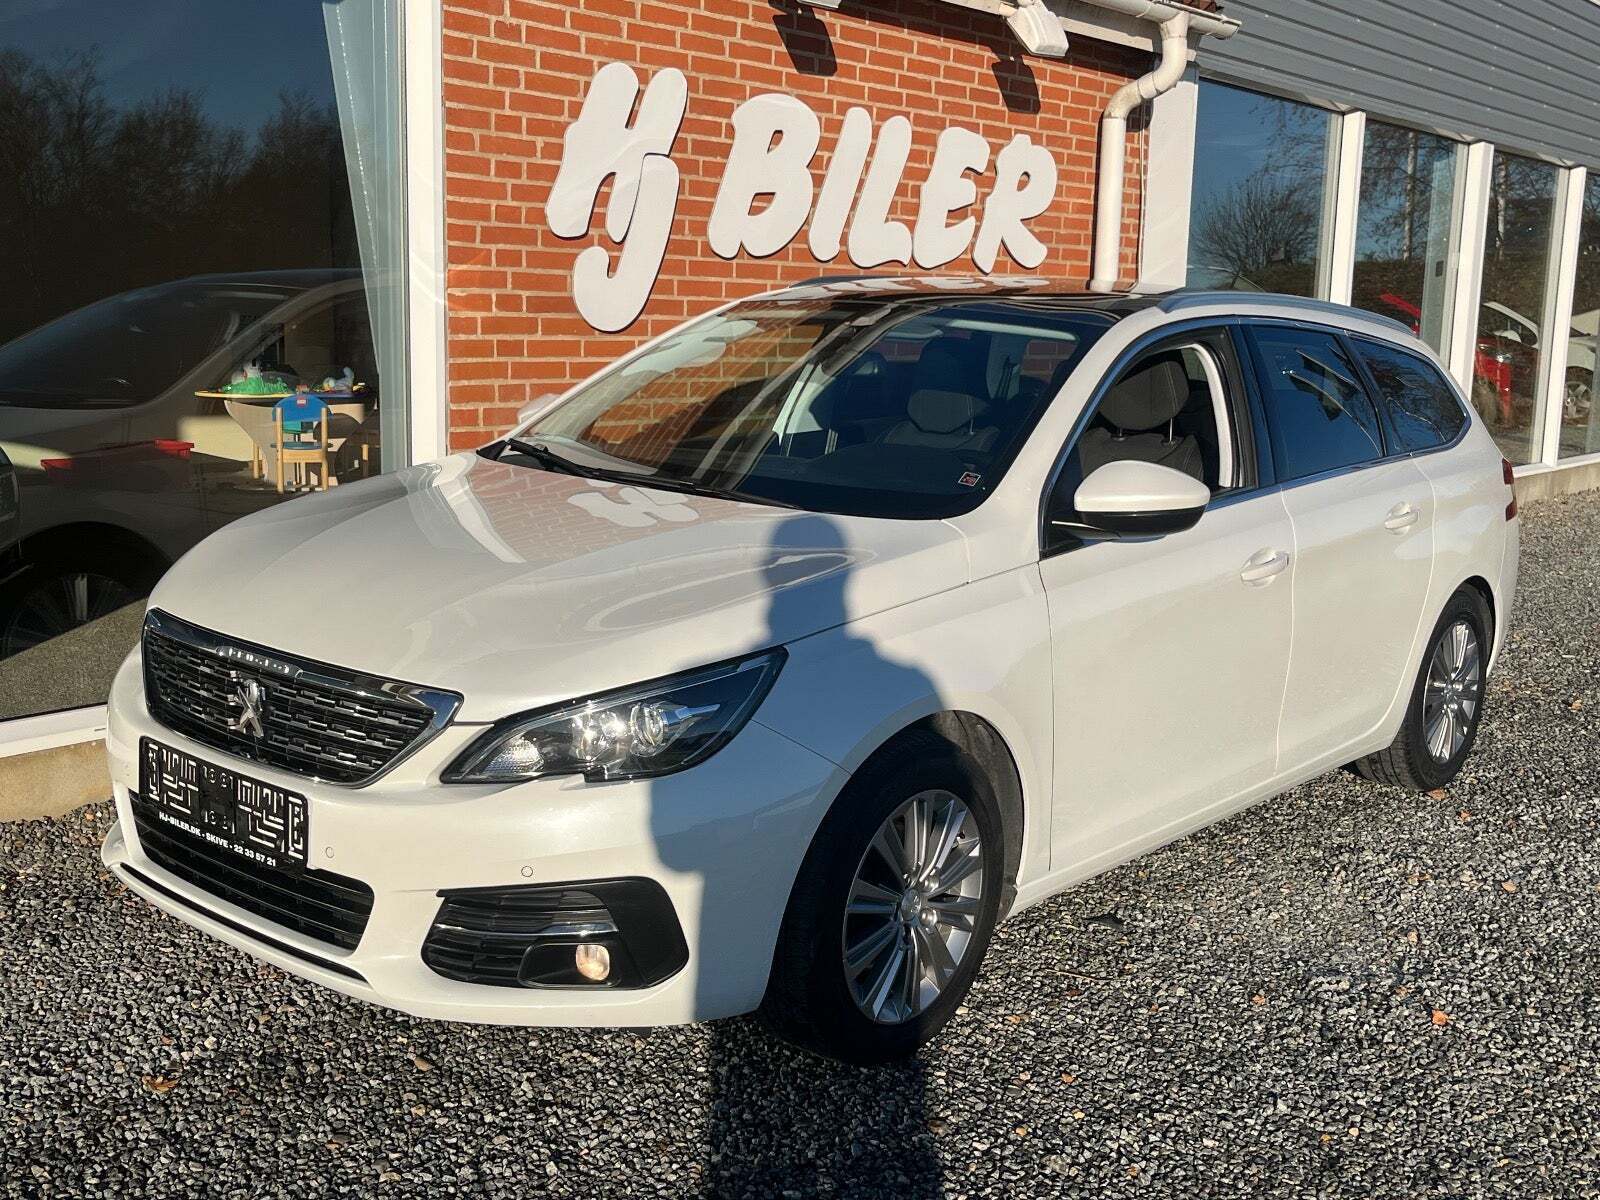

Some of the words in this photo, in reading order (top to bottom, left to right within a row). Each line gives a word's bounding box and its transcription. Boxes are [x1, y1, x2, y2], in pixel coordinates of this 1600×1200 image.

[545, 62, 687, 333] HJ
[708, 93, 1058, 275] BILER
[159, 811, 201, 837] HJ-BILER.DK
[205, 832, 229, 848] SKIVE
[233, 844, 244, 855] 22
[244, 848, 255, 859] 33
[255, 852, 266, 863] 57
[266, 857, 277, 867] 21
